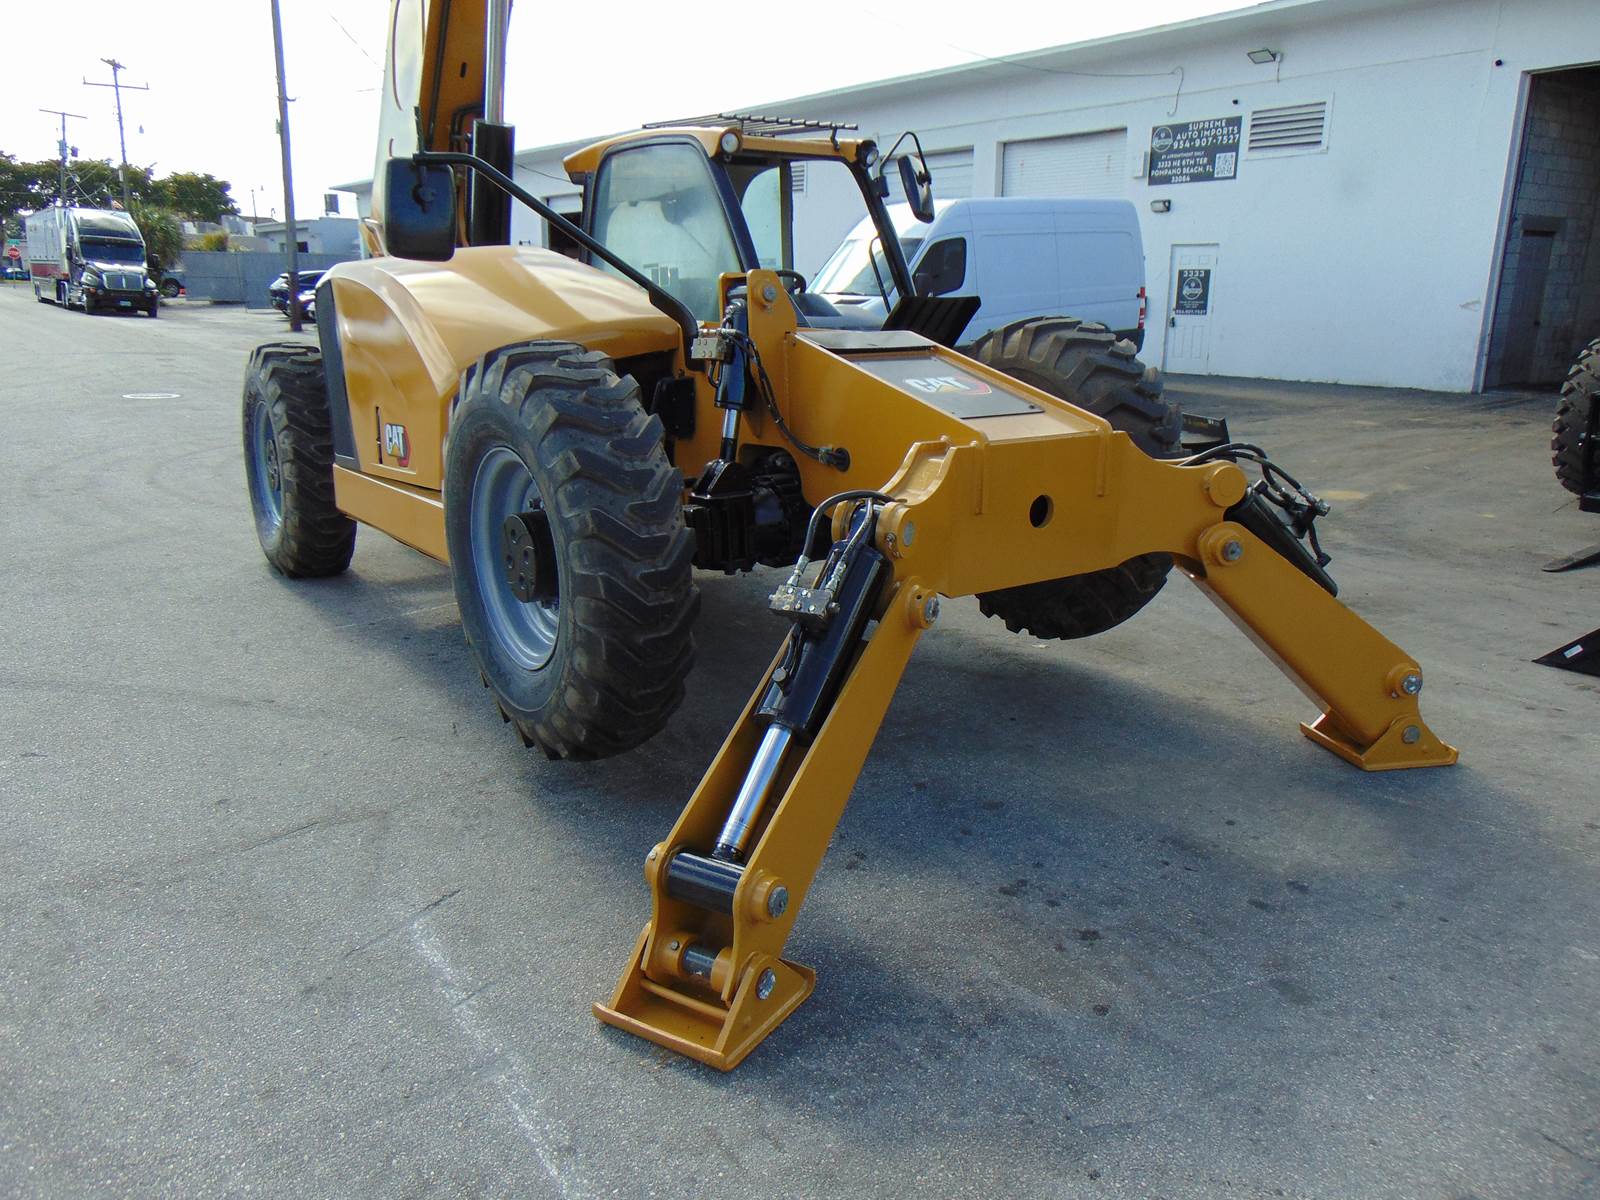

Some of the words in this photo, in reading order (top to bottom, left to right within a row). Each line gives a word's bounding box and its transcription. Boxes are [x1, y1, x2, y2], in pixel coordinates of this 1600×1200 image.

[1188, 119, 1226, 130] SUPREME
[1176, 131, 1198, 140] AUTO
[1200, 126, 1238, 138] IMPORTS
[1157, 160, 1172, 169] 3333
[1172, 159, 1181, 167] NE
[1182, 158, 1195, 166] 6TH
[1196, 157, 1208, 165] TER
[1151, 167, 1182, 177] POMPANO
[1182, 165, 1205, 174] BEACH,
[1206, 164, 1213, 173] FL
[1171, 175, 1190, 183] 33064
[904, 376, 971, 393] CAT
[384, 423, 405, 457] CAT
